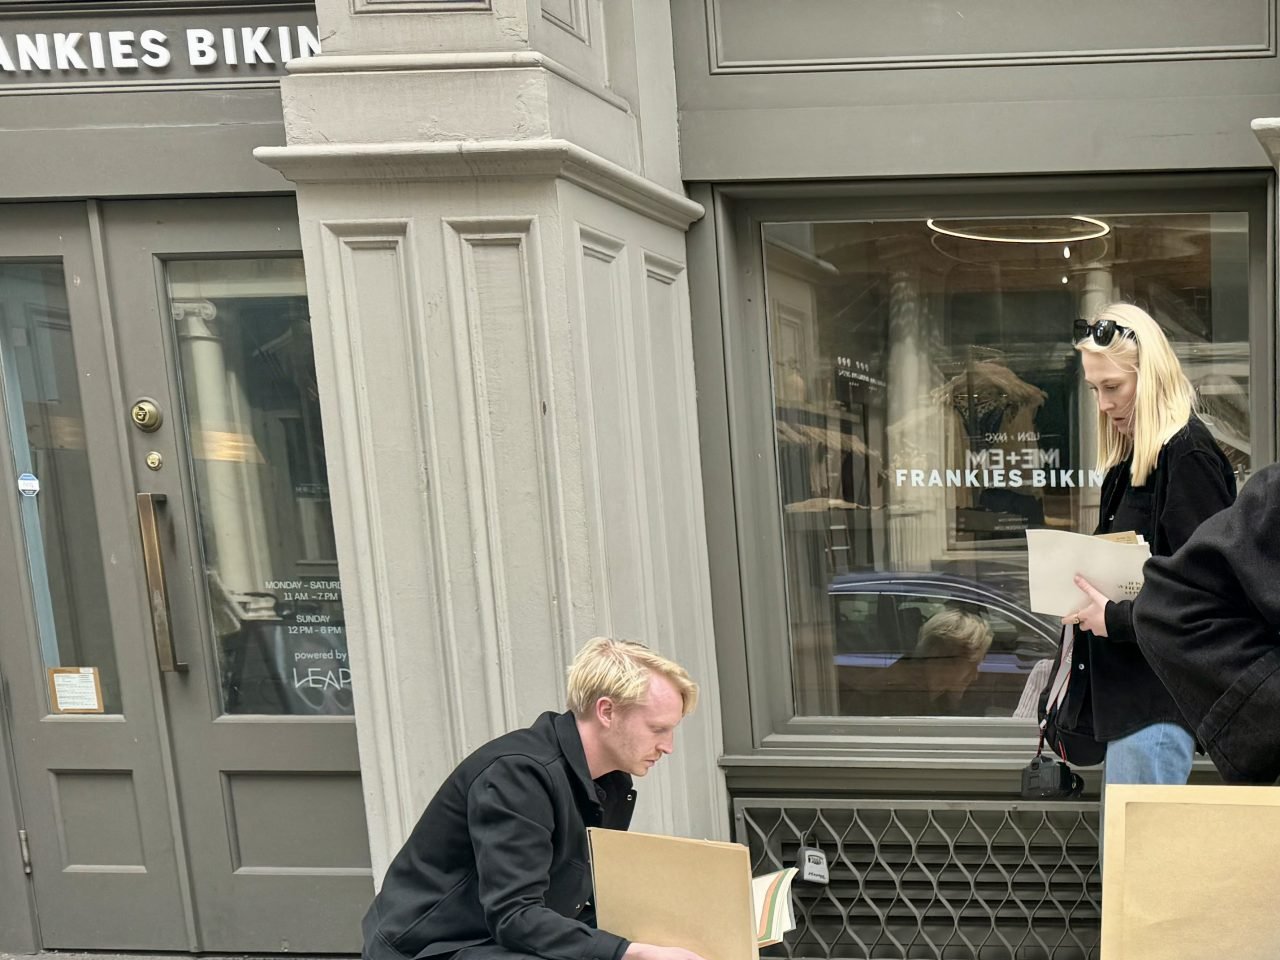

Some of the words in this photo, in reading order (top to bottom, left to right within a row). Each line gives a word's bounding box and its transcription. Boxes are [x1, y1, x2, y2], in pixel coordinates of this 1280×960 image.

[896, 469, 1023, 488] FRANKIES
[265, 581, 302, 590] MONDAY
[284, 592, 294, 600] 11
[295, 592, 309, 600] AM
[319, 592, 324, 600] 7
[325, 592, 338, 600] PM
[296, 615, 330, 623] SUNDAY
[288, 626, 298, 634] 12
[300, 626, 313, 634] PM
[328, 626, 341, 634] PM
[295, 650, 333, 661] powered
[335, 649, 347, 661] by
